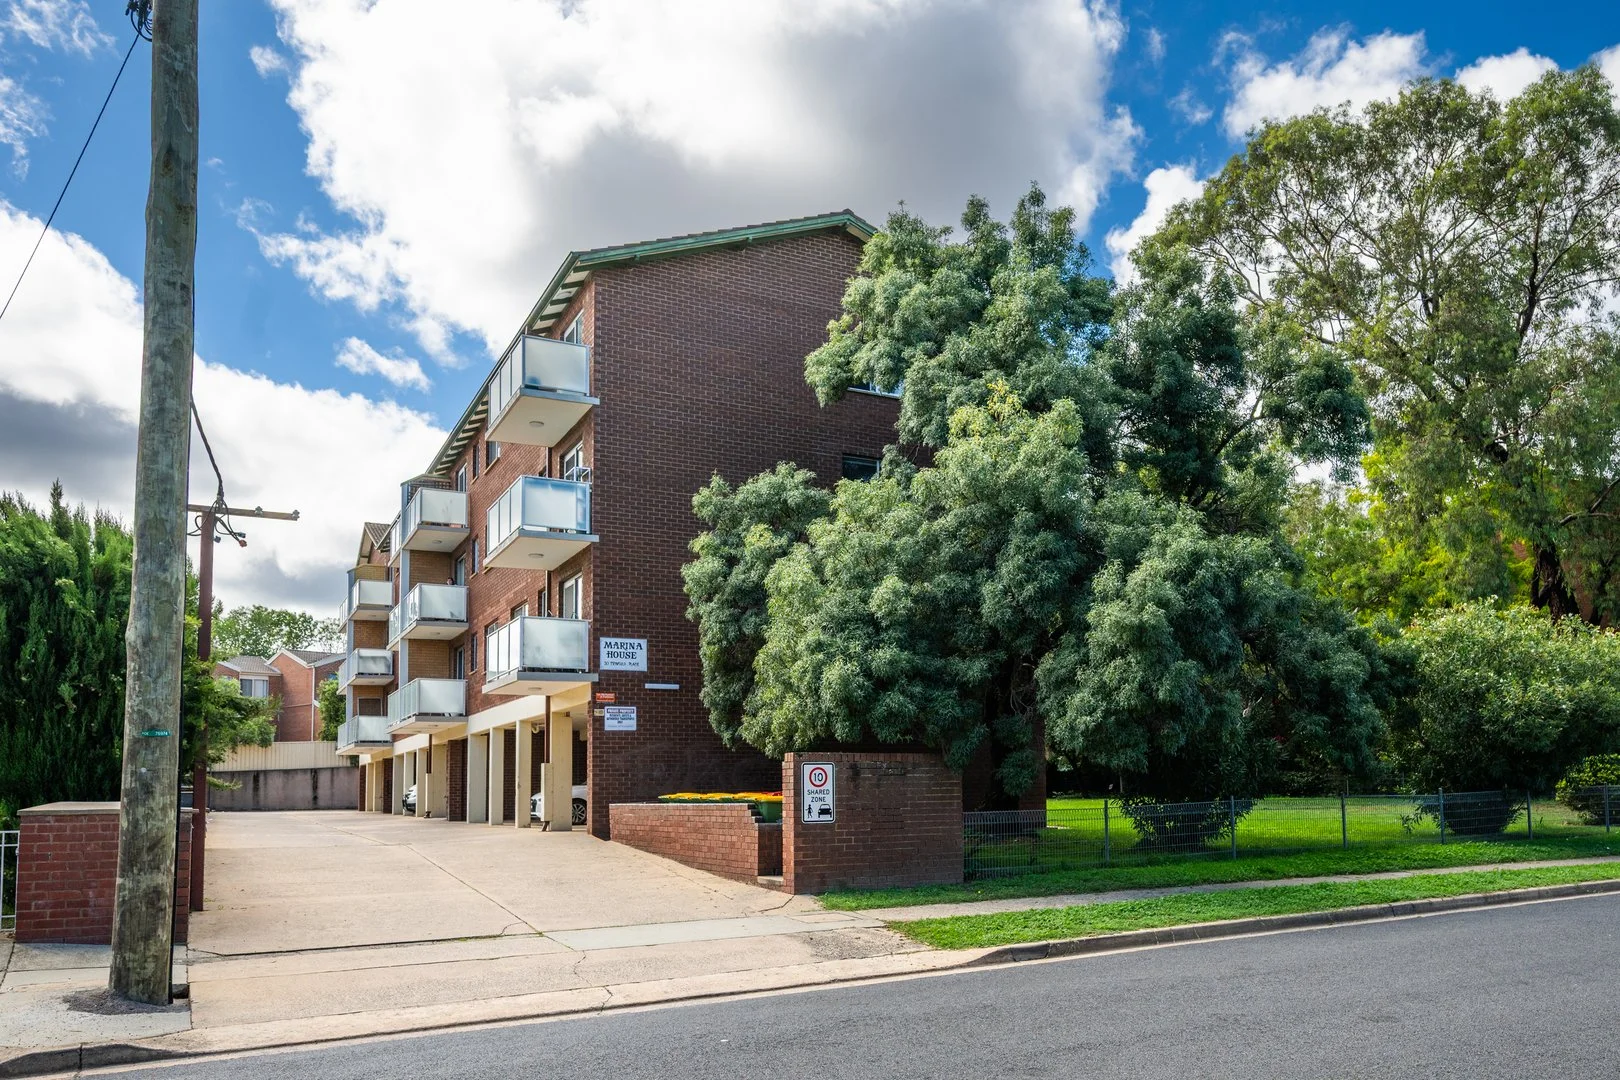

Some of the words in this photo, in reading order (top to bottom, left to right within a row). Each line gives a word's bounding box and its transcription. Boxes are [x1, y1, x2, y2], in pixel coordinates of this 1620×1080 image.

[604, 641, 643, 651] MARINA
[606, 650, 637, 660] HOUSE
[813, 772, 824, 782] 10
